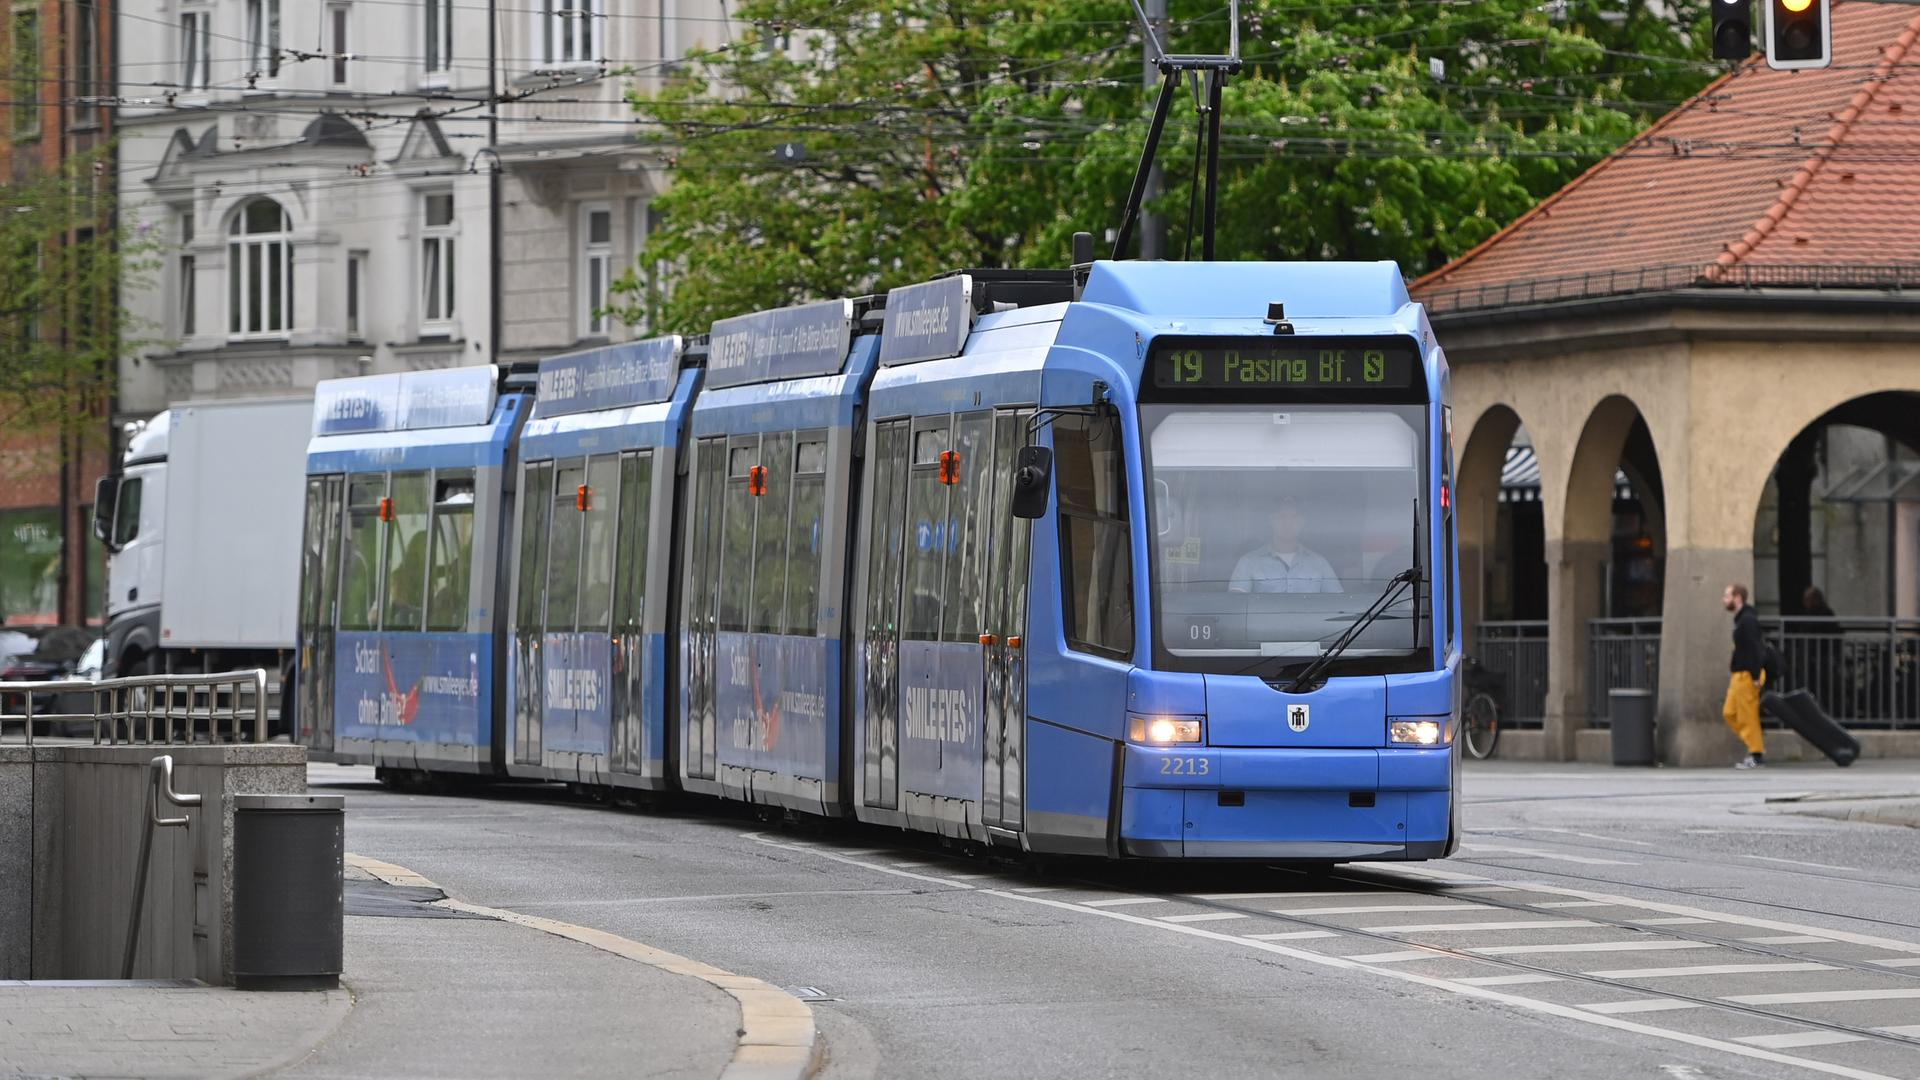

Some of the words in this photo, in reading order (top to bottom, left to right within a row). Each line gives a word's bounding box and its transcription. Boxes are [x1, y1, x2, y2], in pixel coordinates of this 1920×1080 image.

[895, 296, 949, 345] www.smileeyes.de
[1170, 350, 1203, 382] 19
[1224, 350, 1307, 382] Pasing
[1319, 350, 1351, 382] Bf.
[558, 367, 576, 400] EYES
[1190, 625, 1212, 640] 09
[423, 670, 478, 701] www.smileeyes.de
[547, 668, 573, 710] SMILE
[574, 669, 598, 712] EYES
[358, 690, 379, 725] ohne
[380, 692, 407, 726] Brille?
[905, 685, 937, 740] SMILE
[938, 688, 967, 744] EYES
[733, 704, 750, 750] ohne
[1160, 757, 1209, 775] 2213
